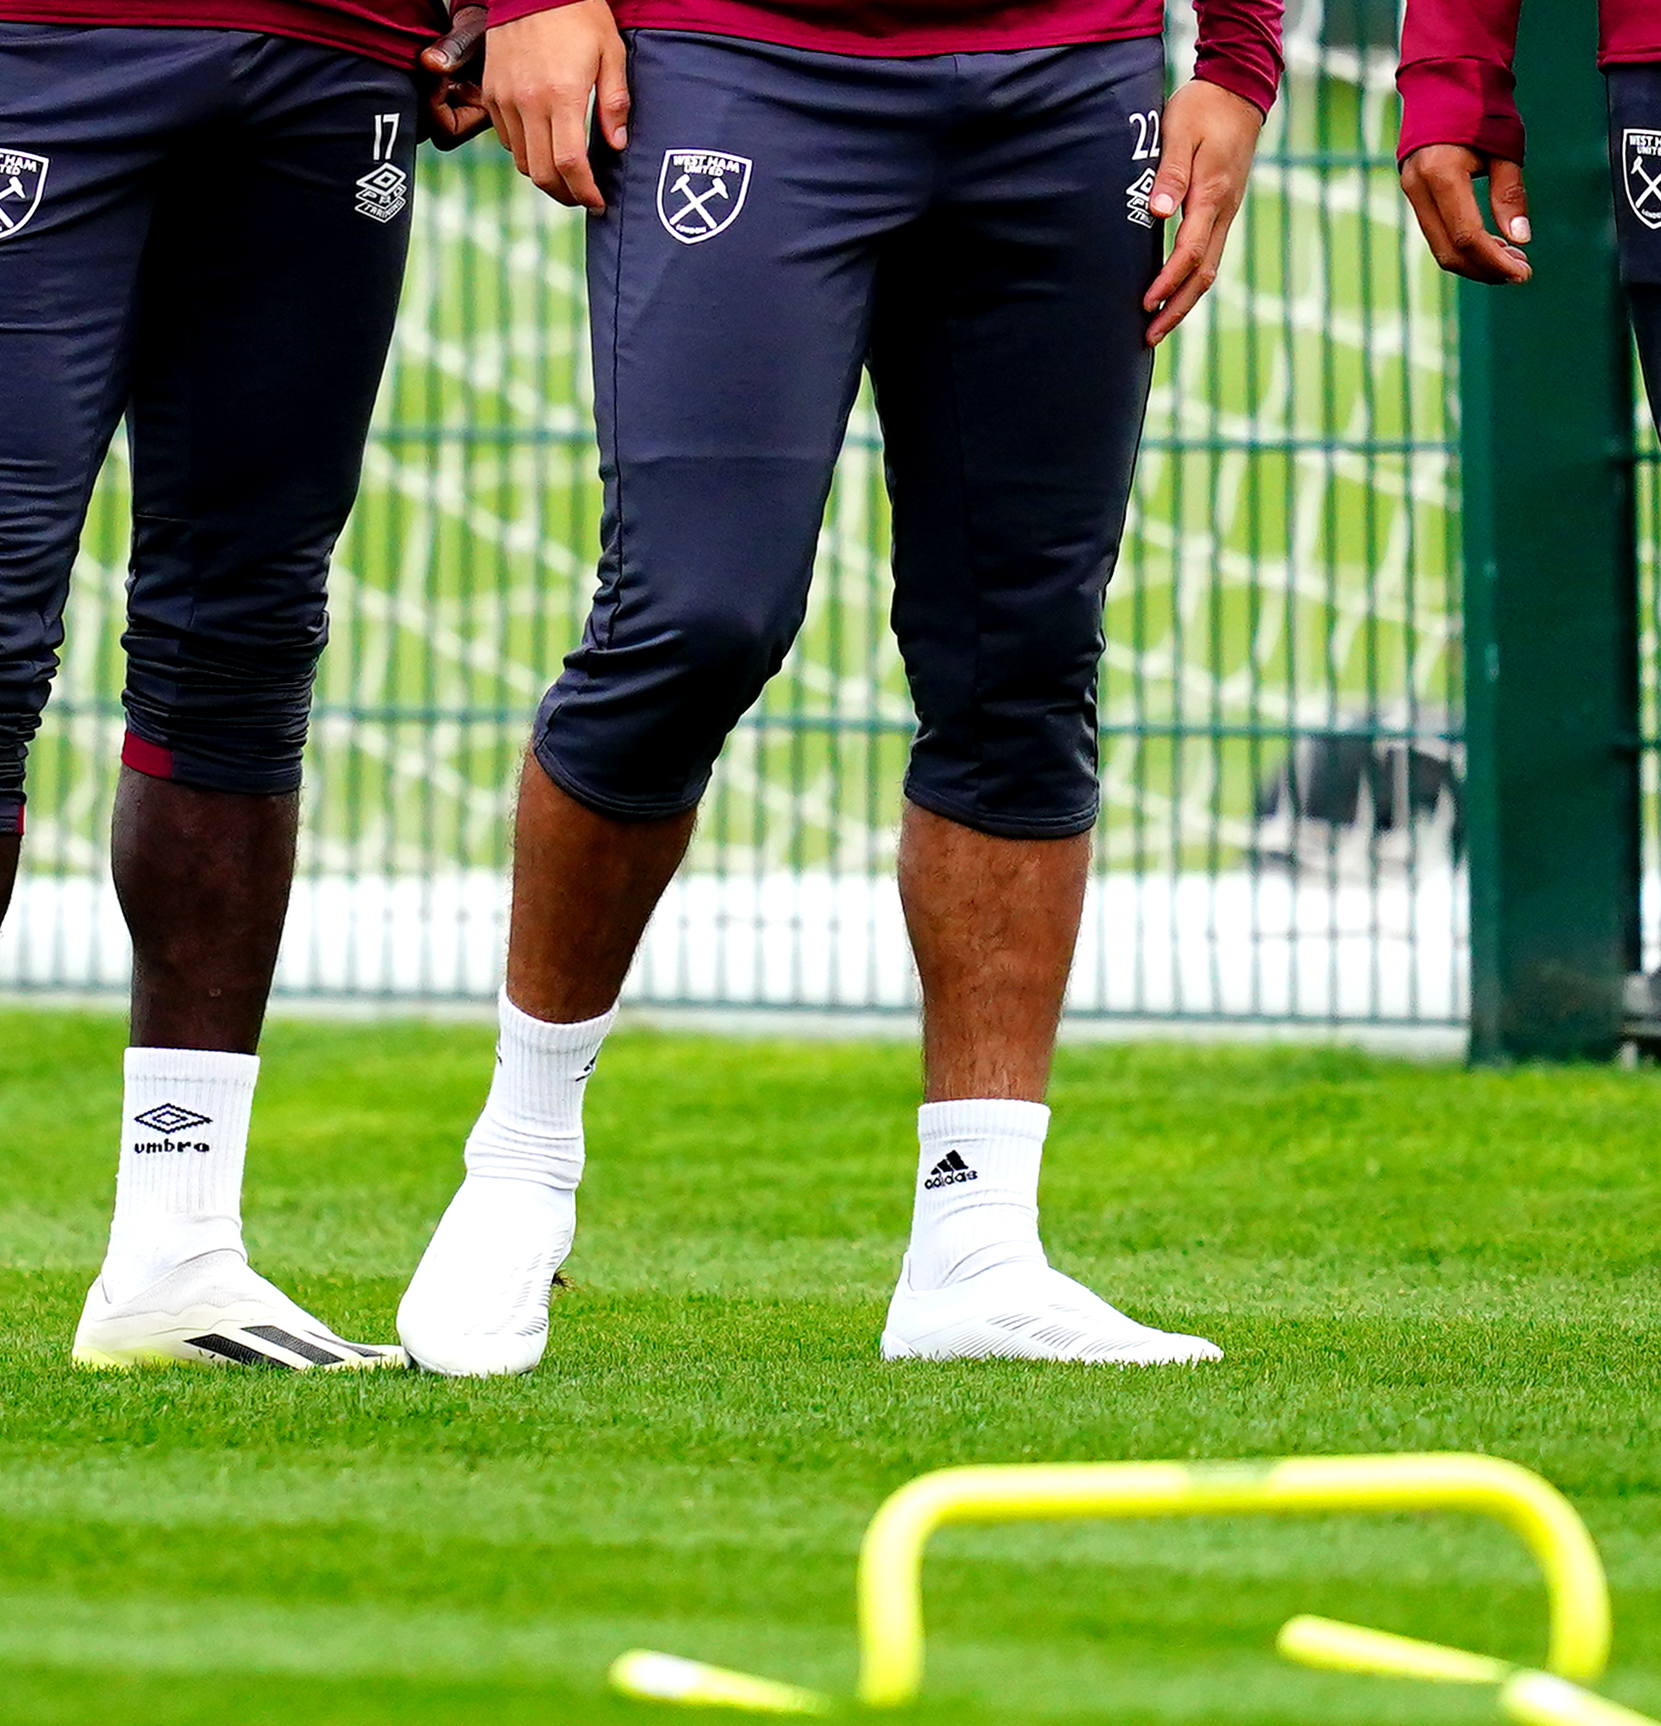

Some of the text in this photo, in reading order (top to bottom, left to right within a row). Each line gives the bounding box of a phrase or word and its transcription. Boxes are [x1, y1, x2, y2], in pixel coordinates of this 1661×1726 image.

[373, 112, 400, 161] 17
[1128, 109, 1160, 161] 22
[5, 154, 37, 172] HAM
[673, 155, 740, 173] WEST HAM
[134, 1138, 210, 1154] umbro
